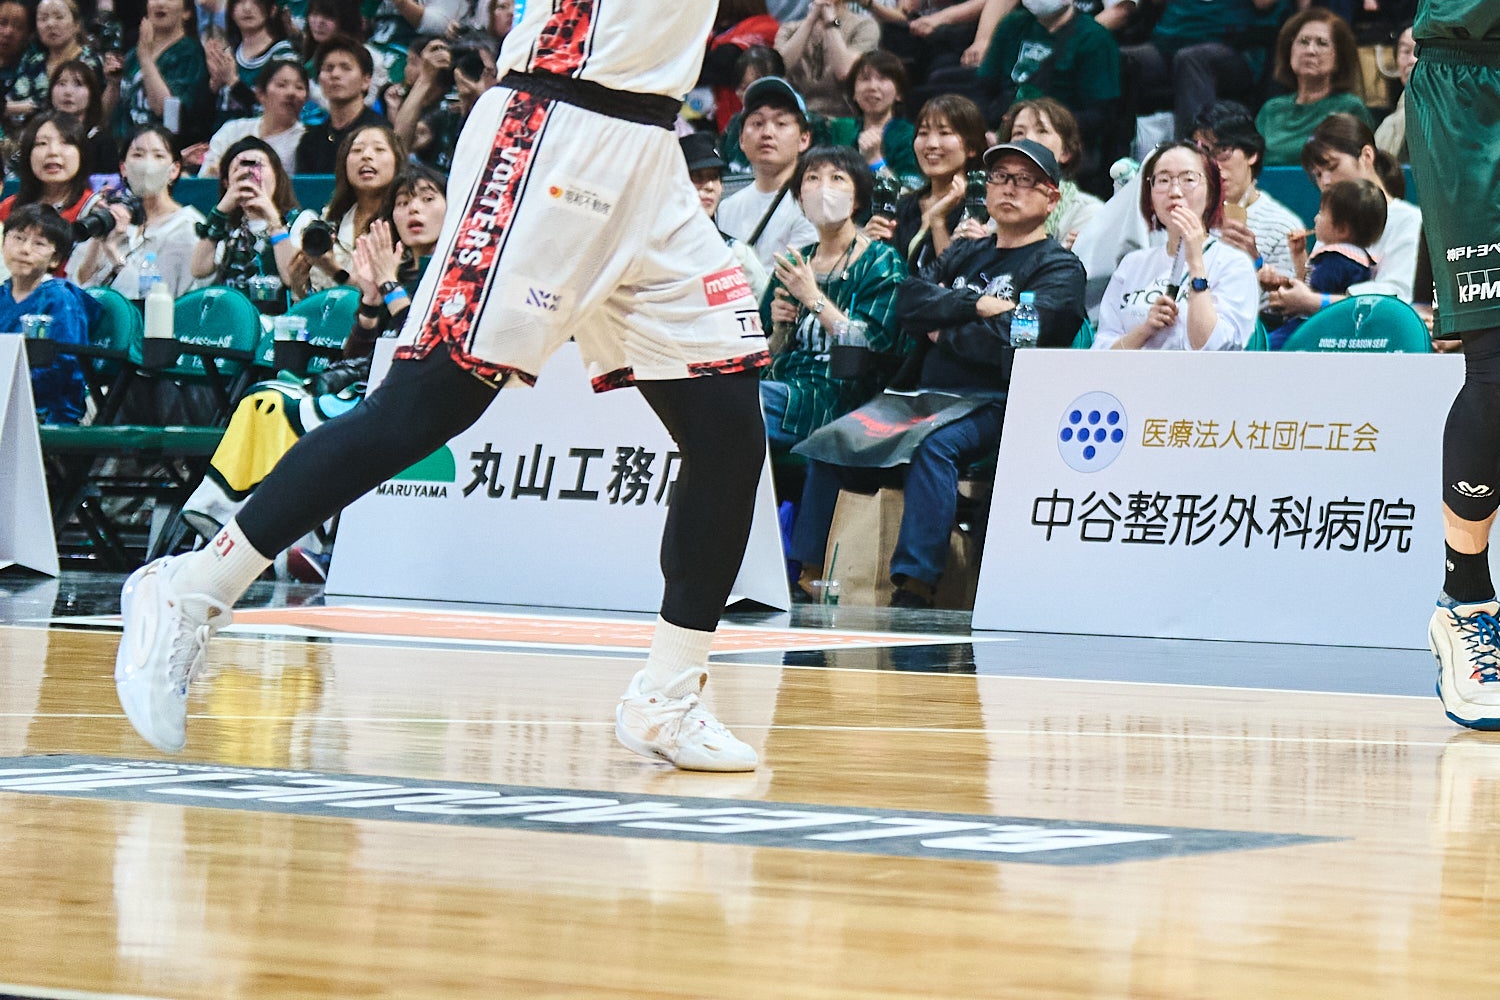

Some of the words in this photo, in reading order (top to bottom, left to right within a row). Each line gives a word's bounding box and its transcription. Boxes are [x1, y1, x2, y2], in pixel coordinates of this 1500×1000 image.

[458, 146, 521, 267] VOLTERS
[1141, 418, 1380, 453] 医療法人社団仁正会
[375, 483, 448, 499] MARUYAMA
[1030, 488, 1416, 553] 中谷整形外科病院
[216, 531, 235, 557] 31
